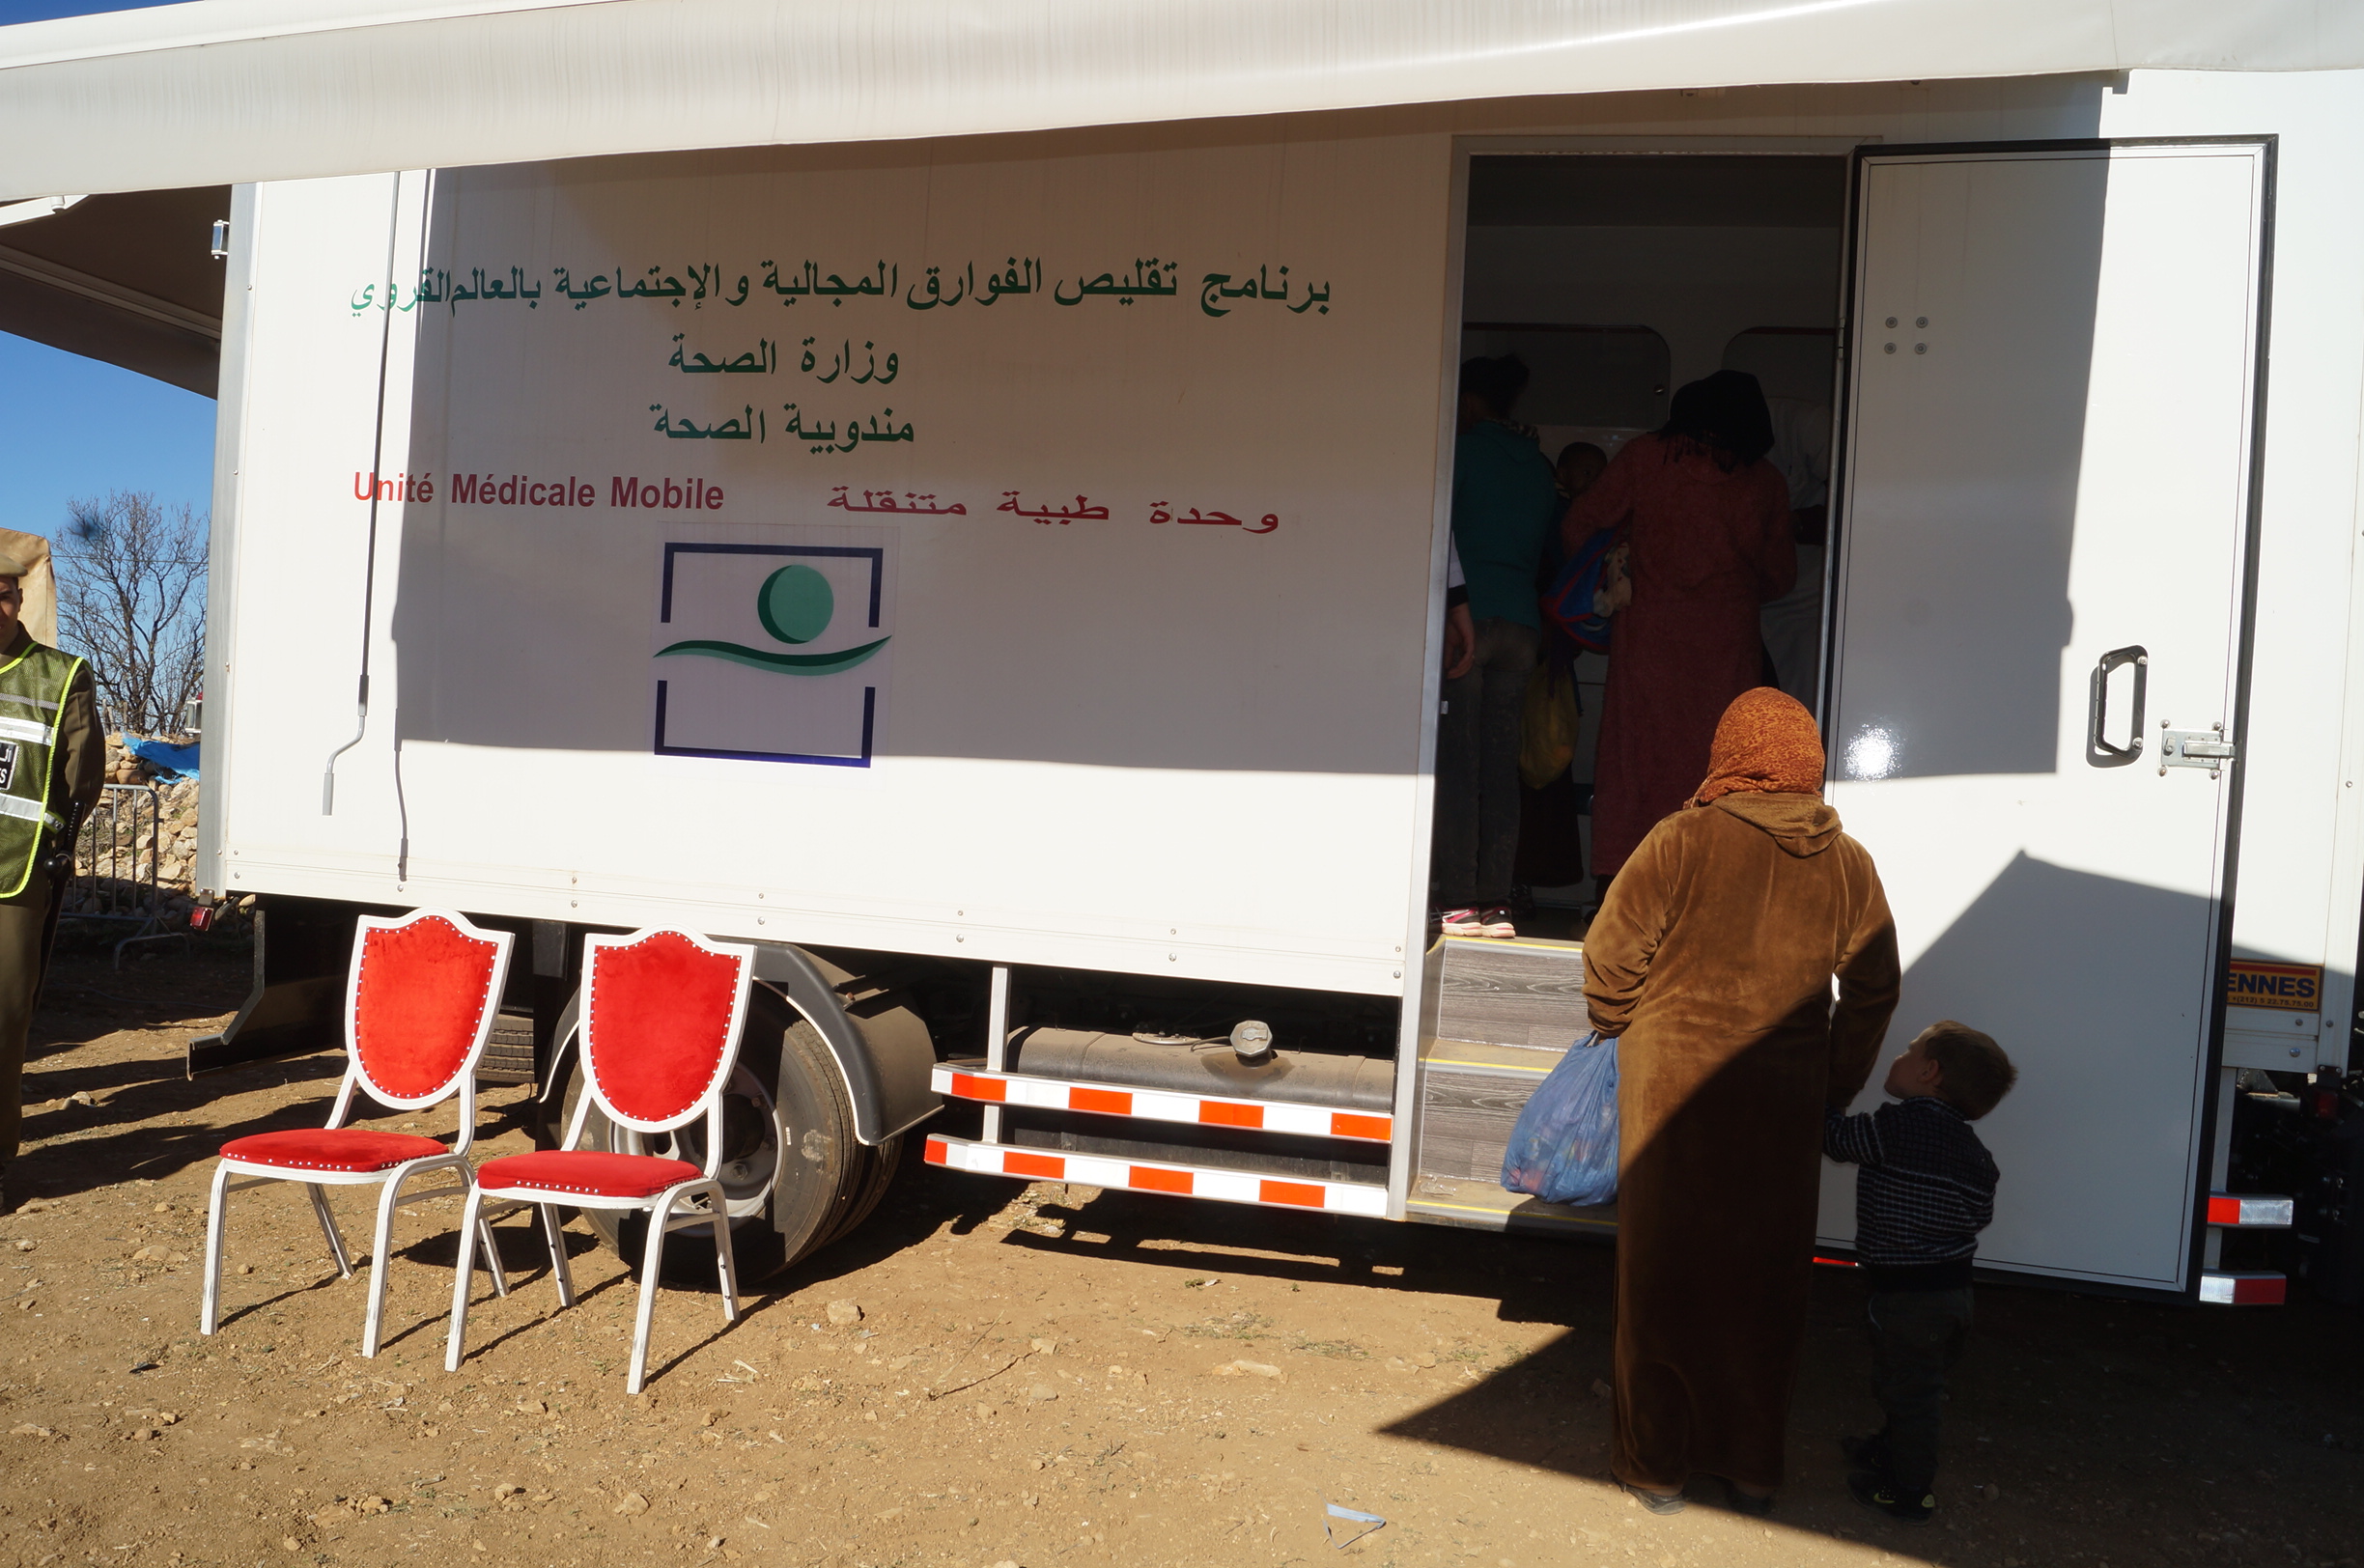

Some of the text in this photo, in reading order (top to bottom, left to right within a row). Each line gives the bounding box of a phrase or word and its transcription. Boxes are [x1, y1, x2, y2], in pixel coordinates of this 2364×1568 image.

[761, 258, 898, 308] المجالية
[906, 256, 1043, 310] الفوارق
[1054, 257, 1177, 307] تقليص
[1200, 263, 1331, 319] برنامج
[668, 332, 899, 385] وزارة الصحة
[649, 403, 915, 454] مندوبية الصحة
[353, 471, 725, 510] Unité Médicale Mobile
[827, 486, 1280, 534] وحدة طبية متنقلة
[2229, 973, 2315, 997] ENNES
